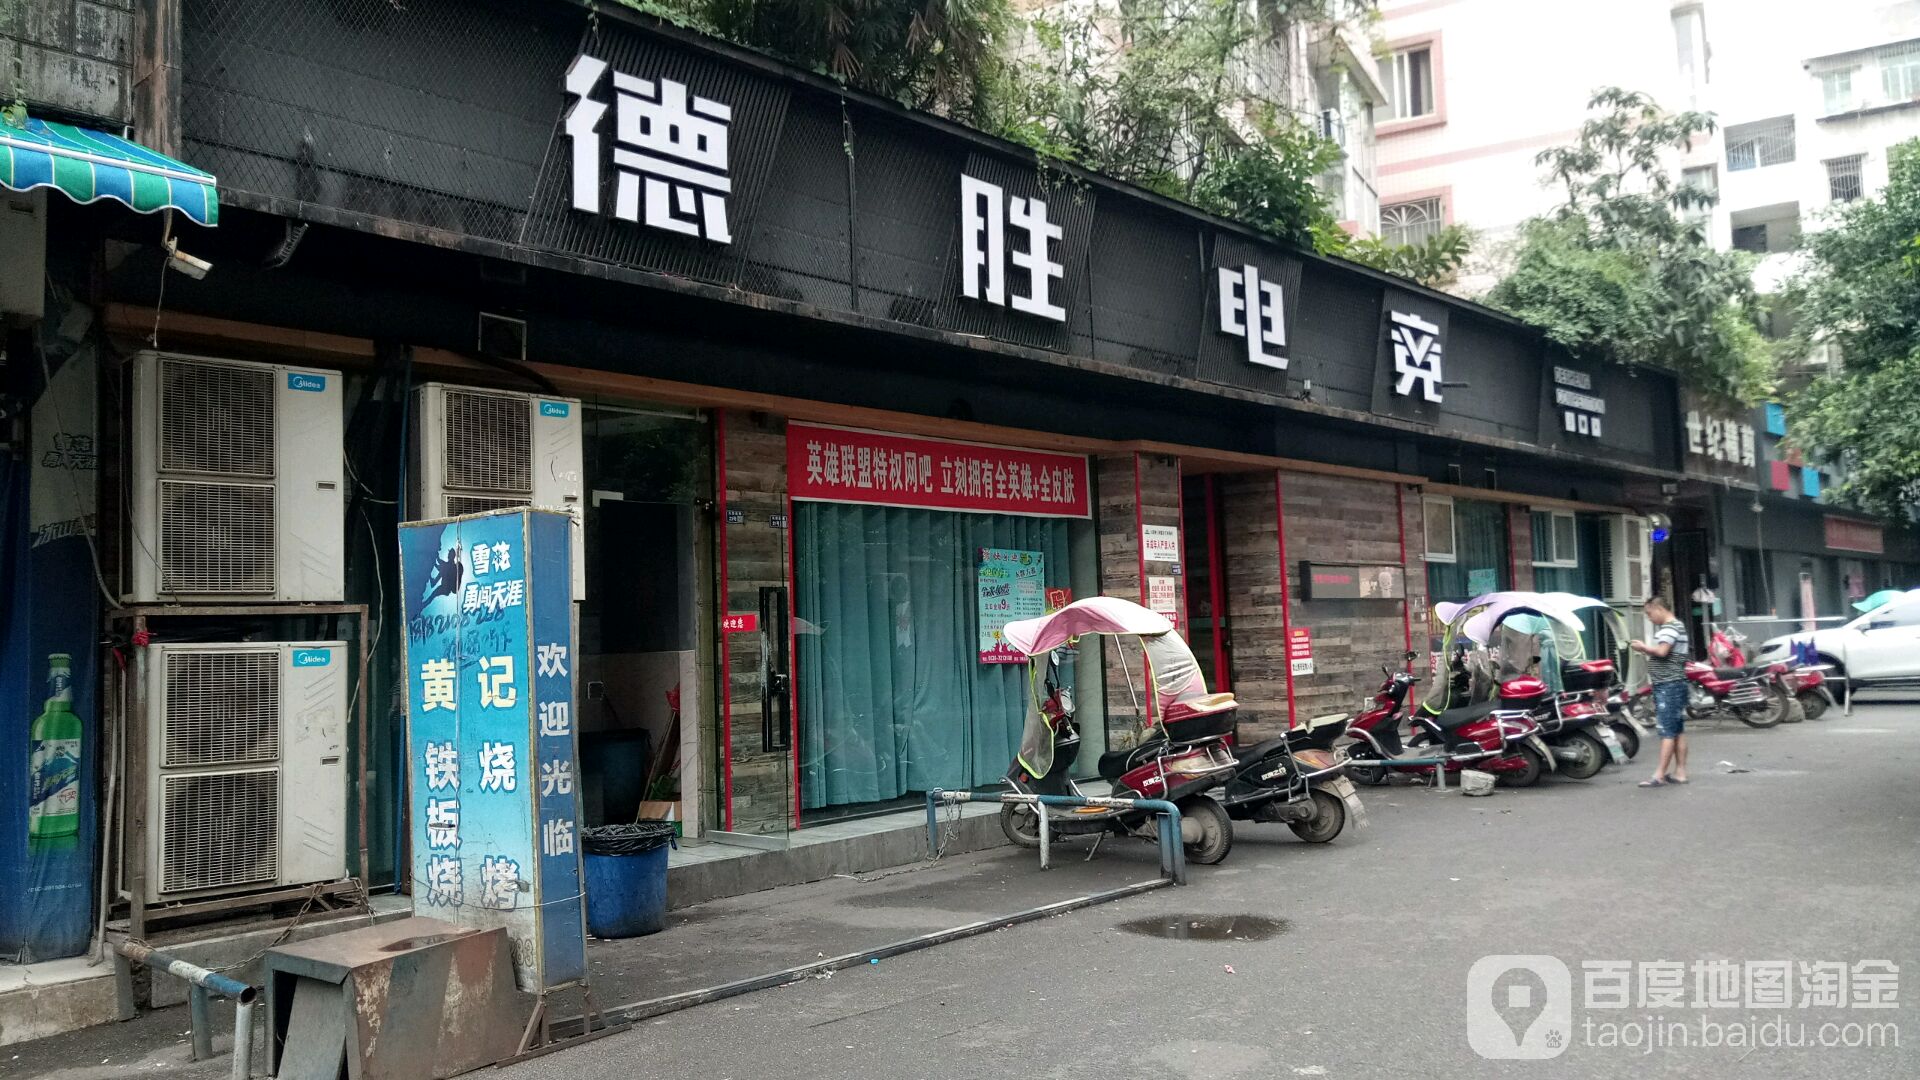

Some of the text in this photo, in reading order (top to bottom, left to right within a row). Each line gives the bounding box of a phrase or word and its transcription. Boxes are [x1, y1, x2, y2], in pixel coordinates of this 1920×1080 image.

[566, 53, 1443, 404] 德胜电竞
[296, 377, 320, 389] Midea
[546, 405, 565, 415] Midea
[807, 440, 1076, 503] 英雄联盟特权网吧 立刻拥有全英雄+全皮肤
[472, 541, 511, 575] 雪花
[463, 580, 523, 613] 勇闯天涯
[301, 654, 326, 664] Midea
[420, 655, 517, 711] 黄记
[537, 642, 574, 857] 欢迎光临
[425, 741, 463, 906] 铁板烧
